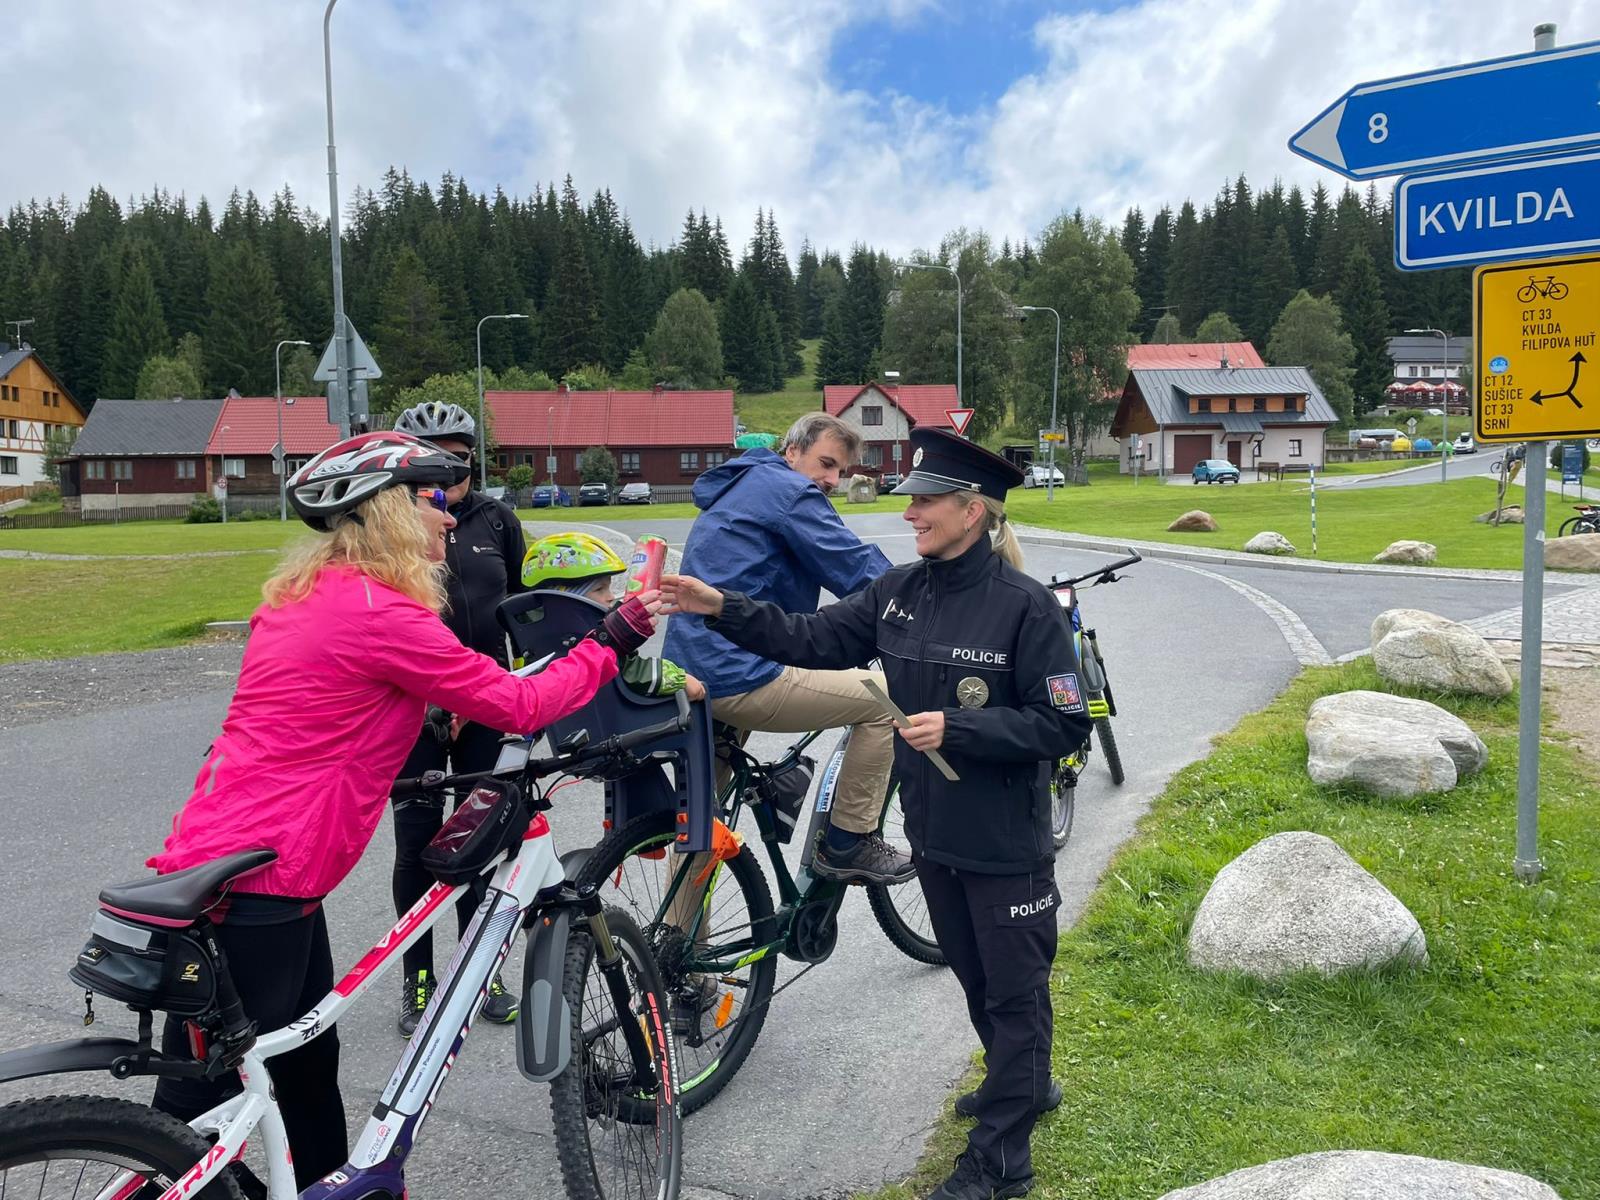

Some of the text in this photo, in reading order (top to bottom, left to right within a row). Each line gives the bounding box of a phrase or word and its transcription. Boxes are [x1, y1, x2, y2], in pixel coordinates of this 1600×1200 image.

[1368, 112, 1388, 144] 8
[1419, 187, 1575, 236] KVILDA
[1522, 308, 1552, 322] CT 33
[1522, 323, 1562, 336] KVILDA
[1522, 331, 1597, 351] FILIPOVA HUŤ
[1484, 374, 1513, 387] CT 12
[1484, 387, 1524, 402] SUŠICE
[1484, 403, 1514, 416] CT 33
[1484, 415, 1511, 430] SRNÍ
[952, 648, 1007, 665] POLICIE
[1009, 893, 1054, 918] POLICIE
